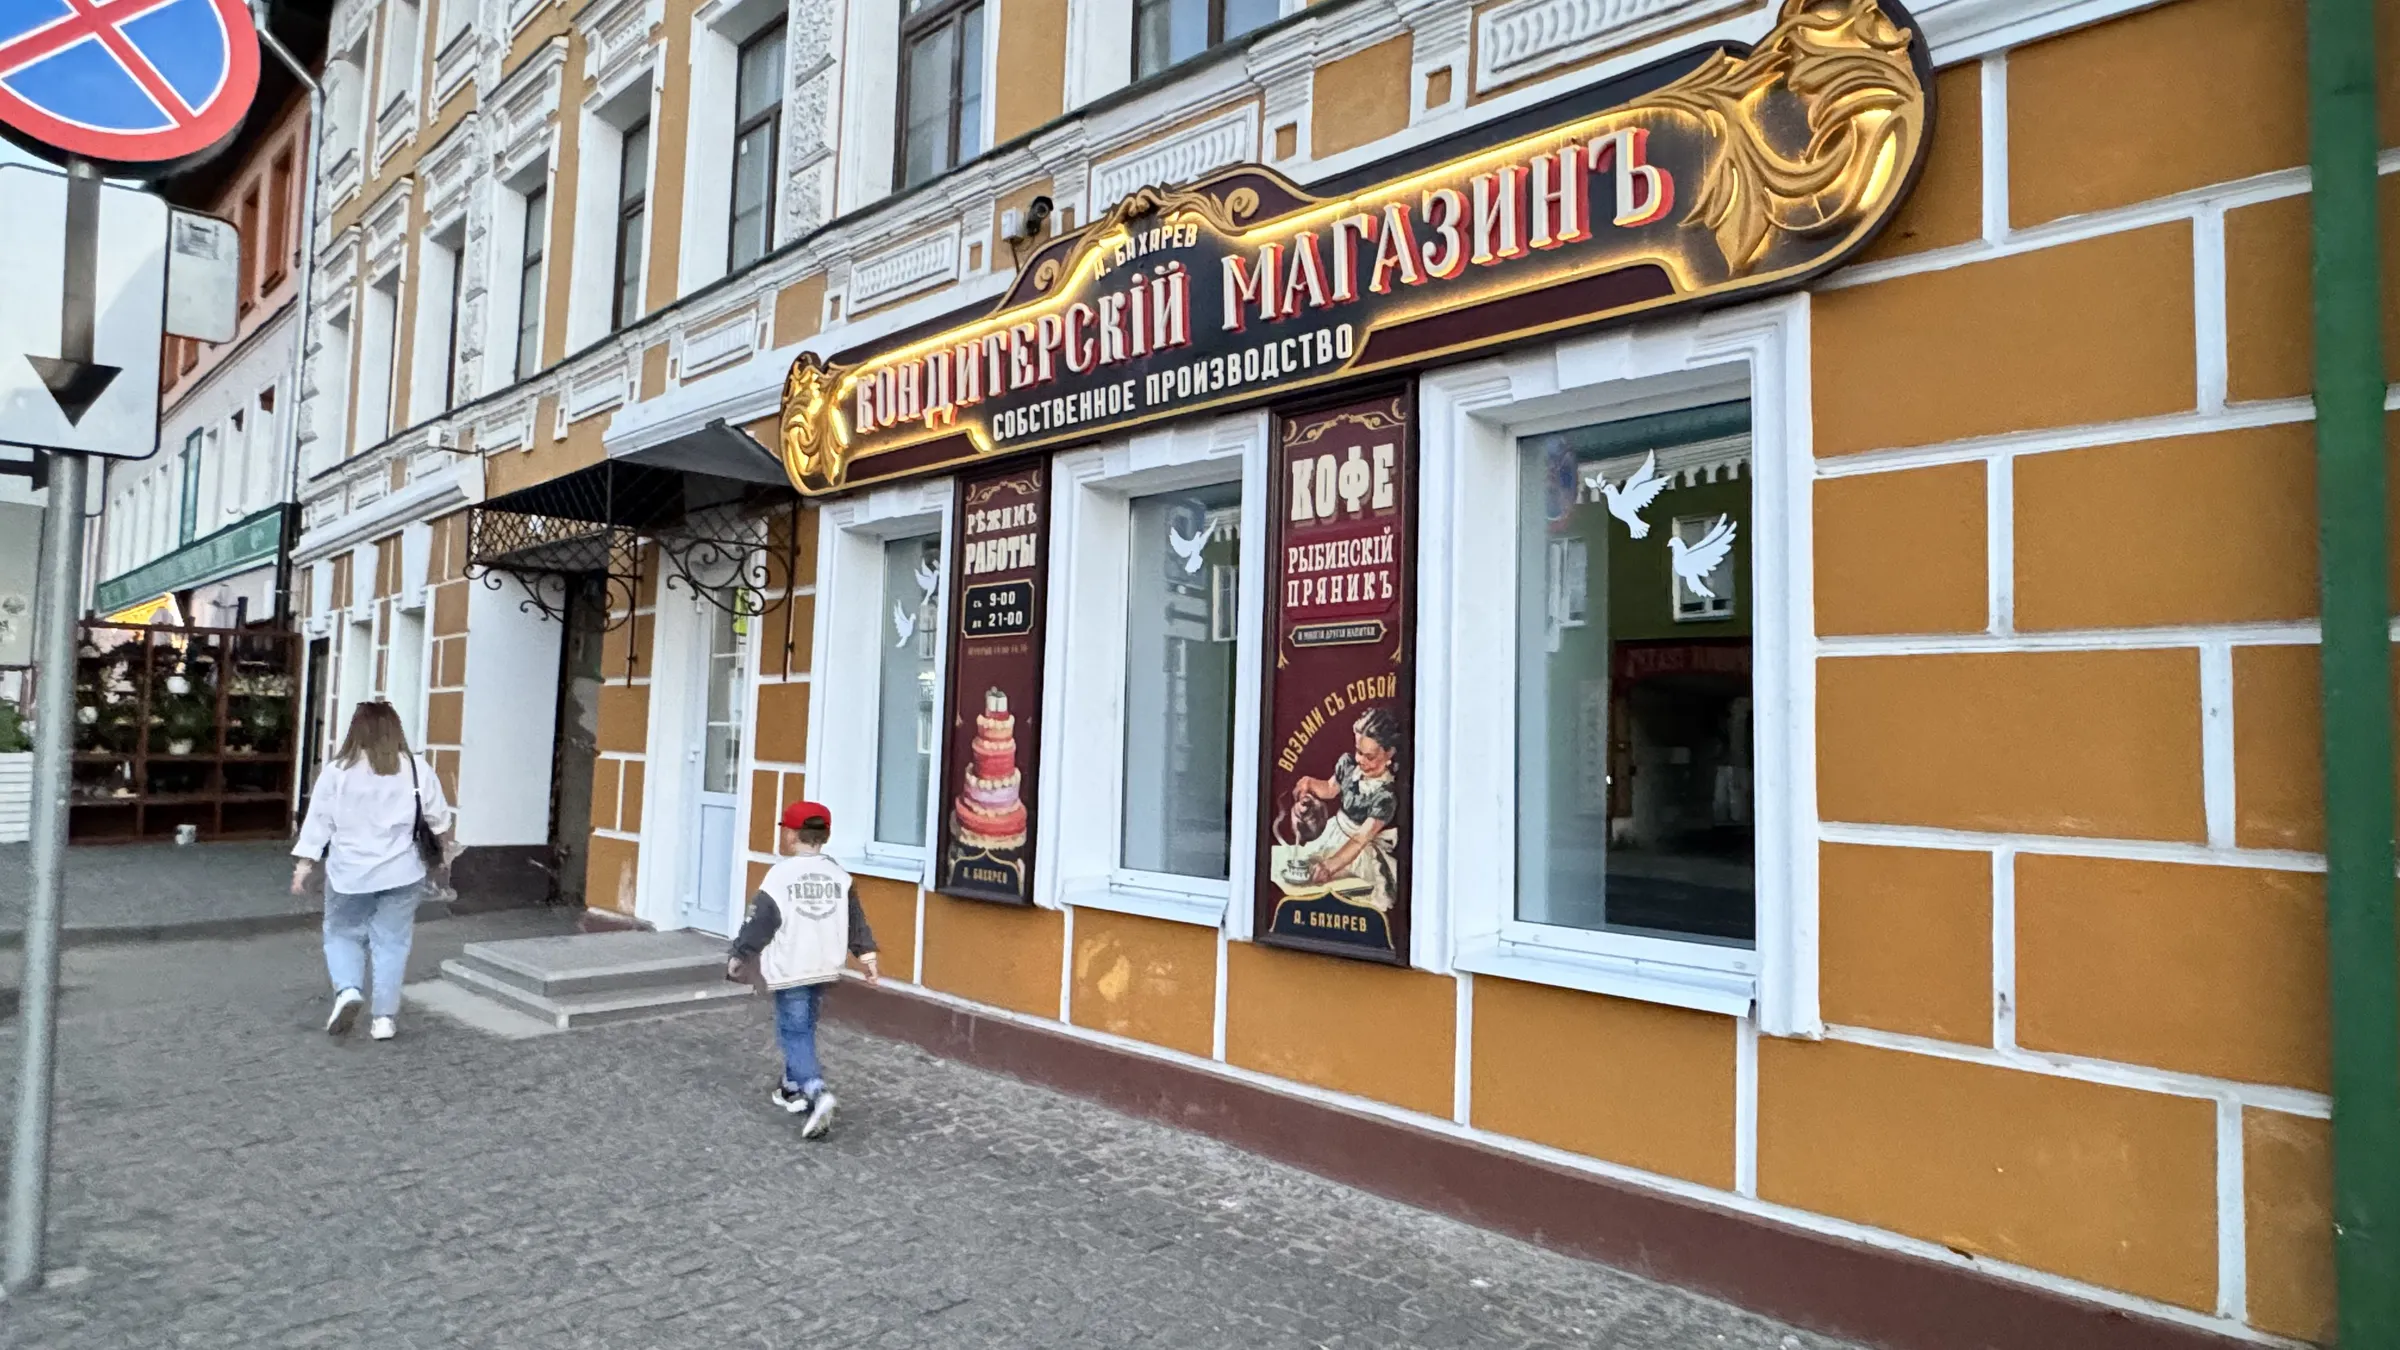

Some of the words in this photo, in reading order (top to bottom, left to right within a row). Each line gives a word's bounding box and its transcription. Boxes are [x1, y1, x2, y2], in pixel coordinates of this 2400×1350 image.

[1114, 222, 1199, 267] БАХАРЕВ
[855, 260, 1190, 432] КОНДИТЕРСКІЙ
[1222, 126, 1672, 332] МАГАЗИНЪ
[992, 378, 1136, 442] СОБСТВЕННОЕ
[1146, 323, 1354, 406] ПРОИЗВОДСТВО
[1291, 443, 1395, 521] КОФЕ
[964, 532, 1038, 575] РАБОТЫ
[1287, 525, 1394, 575] РЫБИНСКІЙ
[989, 590, 1016, 607] 9-00
[1286, 570, 1393, 608] ПРЯНИКЪ
[988, 610, 1024, 627] 21-00
[1277, 706, 1326, 773] ВОЗЬМИ
[1323, 691, 1346, 717] СЪ
[1346, 672, 1397, 705] СОБОЙ
[1293, 909, 1306, 926] А.
[1309, 911, 1368, 933] БАХАРЕВ
